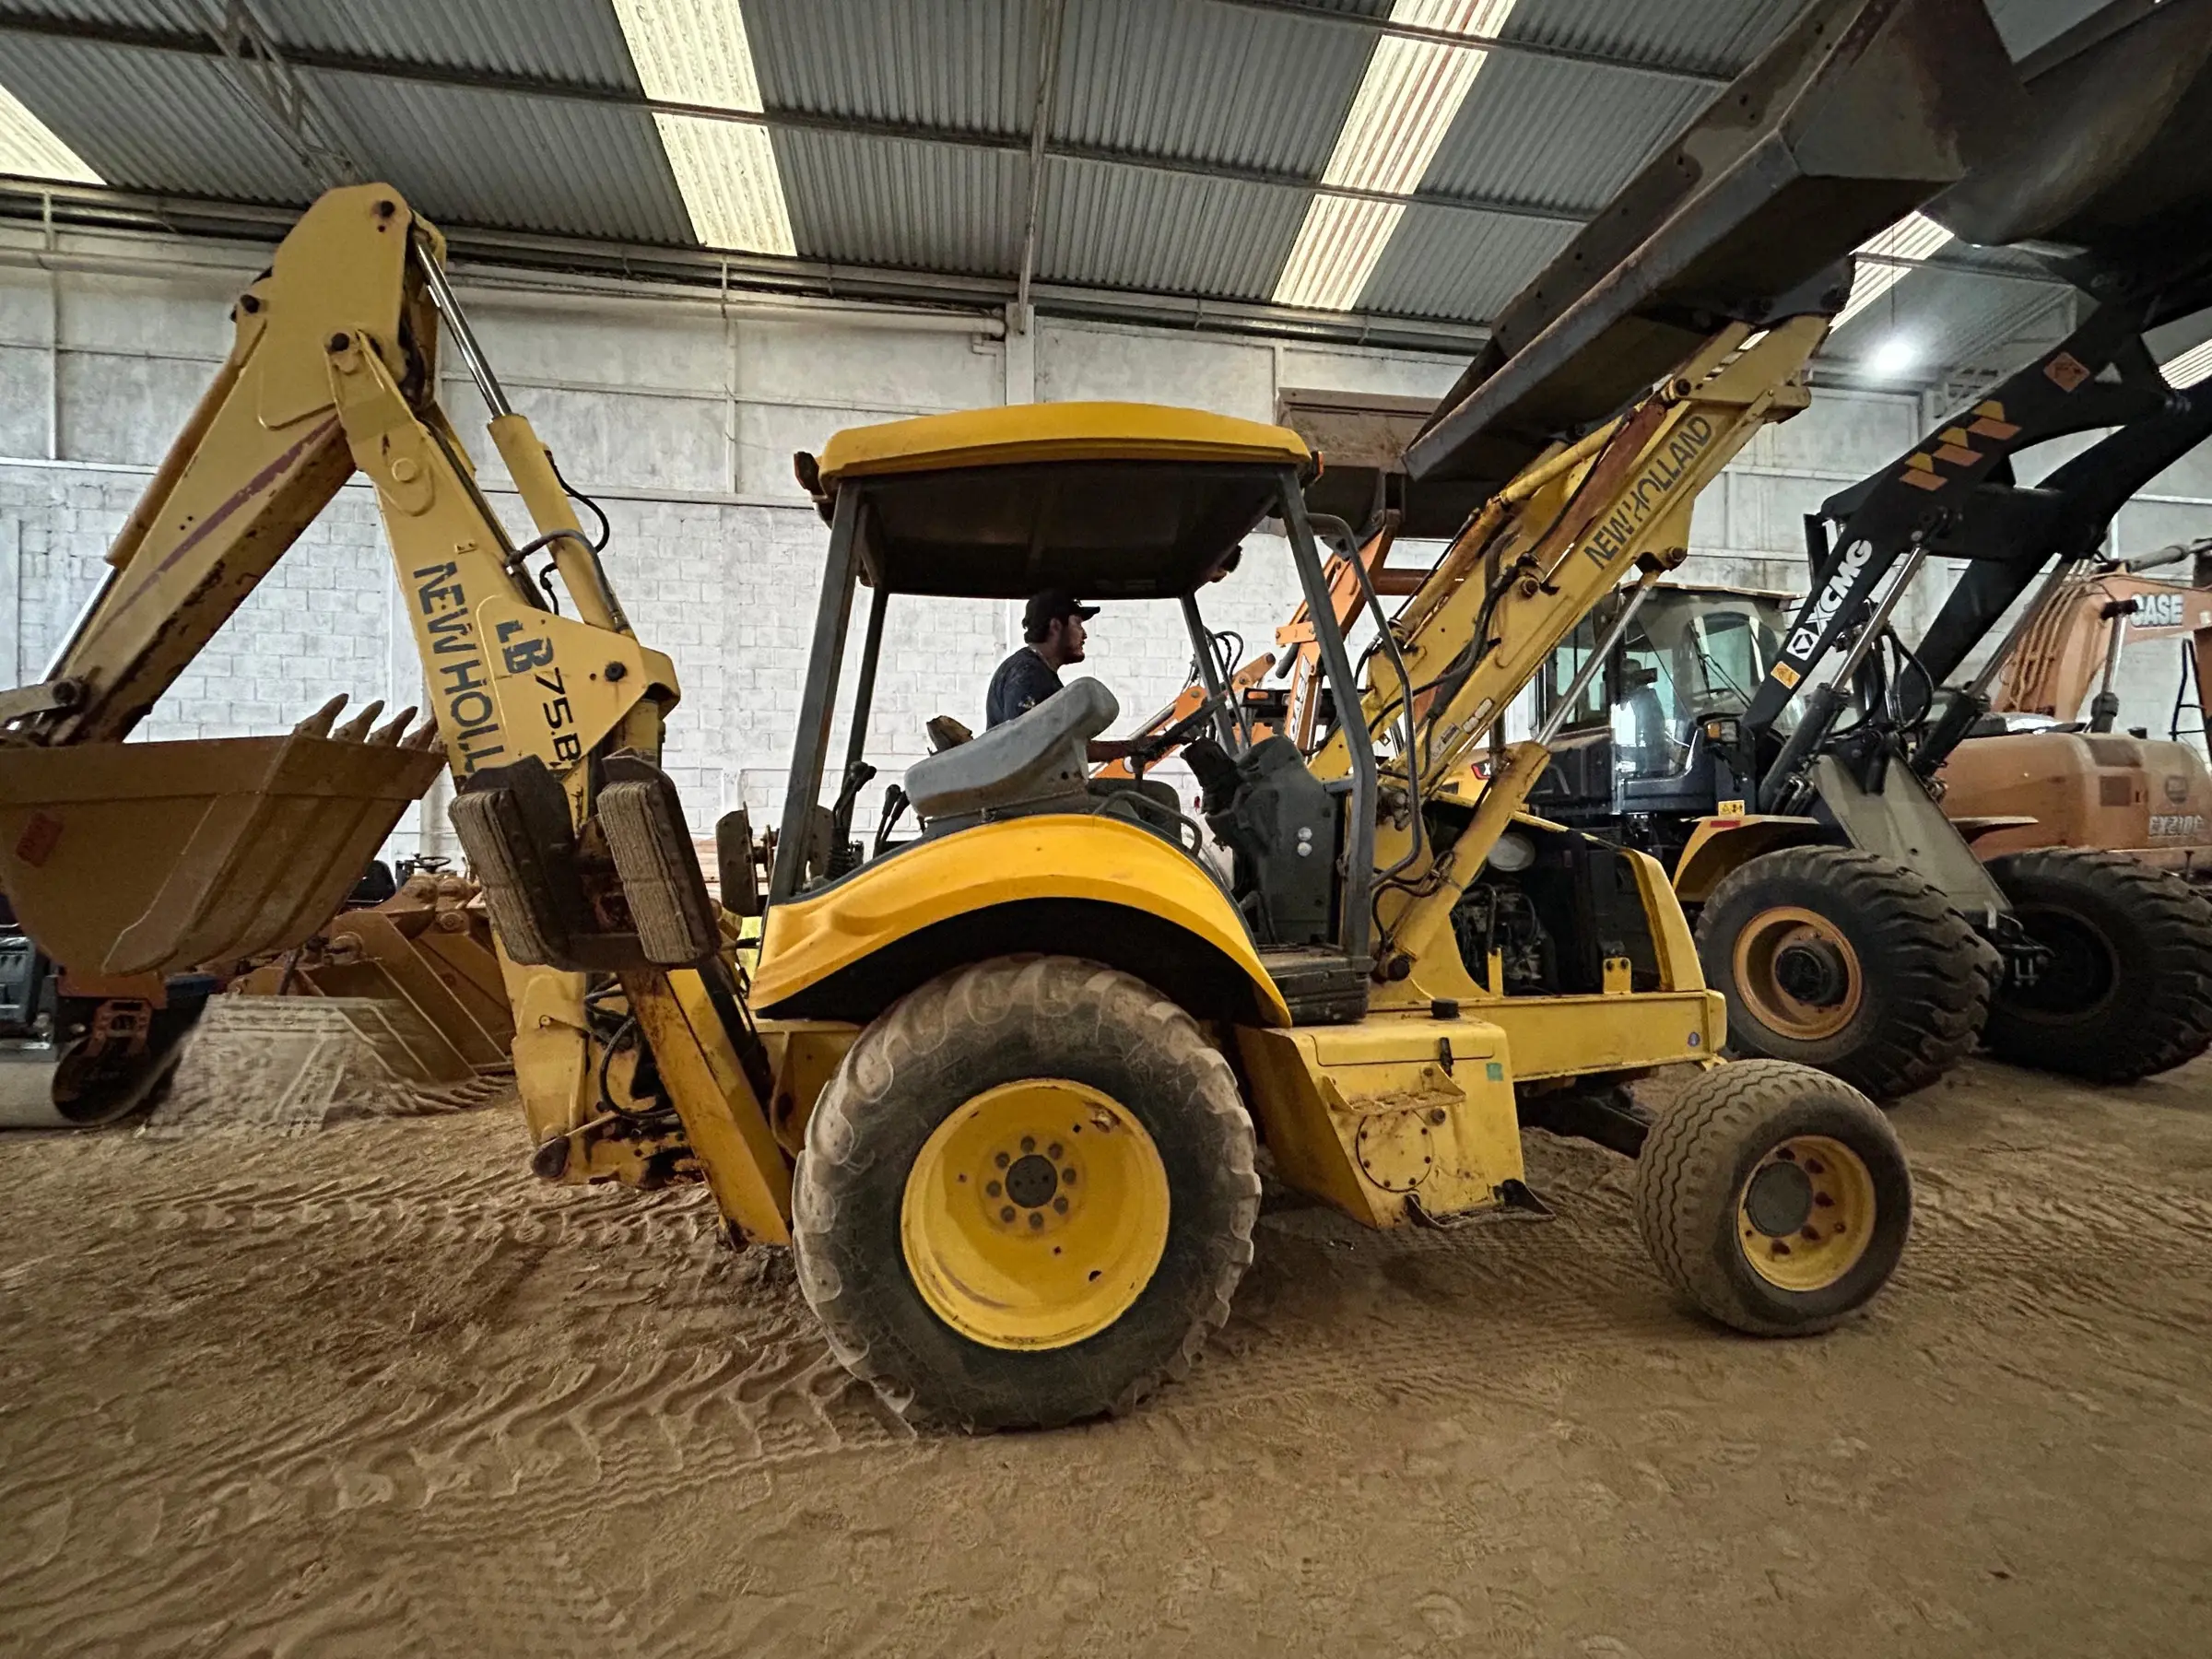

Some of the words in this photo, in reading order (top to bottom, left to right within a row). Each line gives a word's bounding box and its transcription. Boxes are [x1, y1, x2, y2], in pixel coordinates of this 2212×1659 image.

[1583, 508, 1635, 570] NEW
[1623, 416, 1712, 523] HOLLAND
[413, 561, 477, 653] NEW
[1805, 539, 1873, 637] XCMG
[2130, 594, 2184, 626] CASE
[440, 659, 505, 773] HOLL
